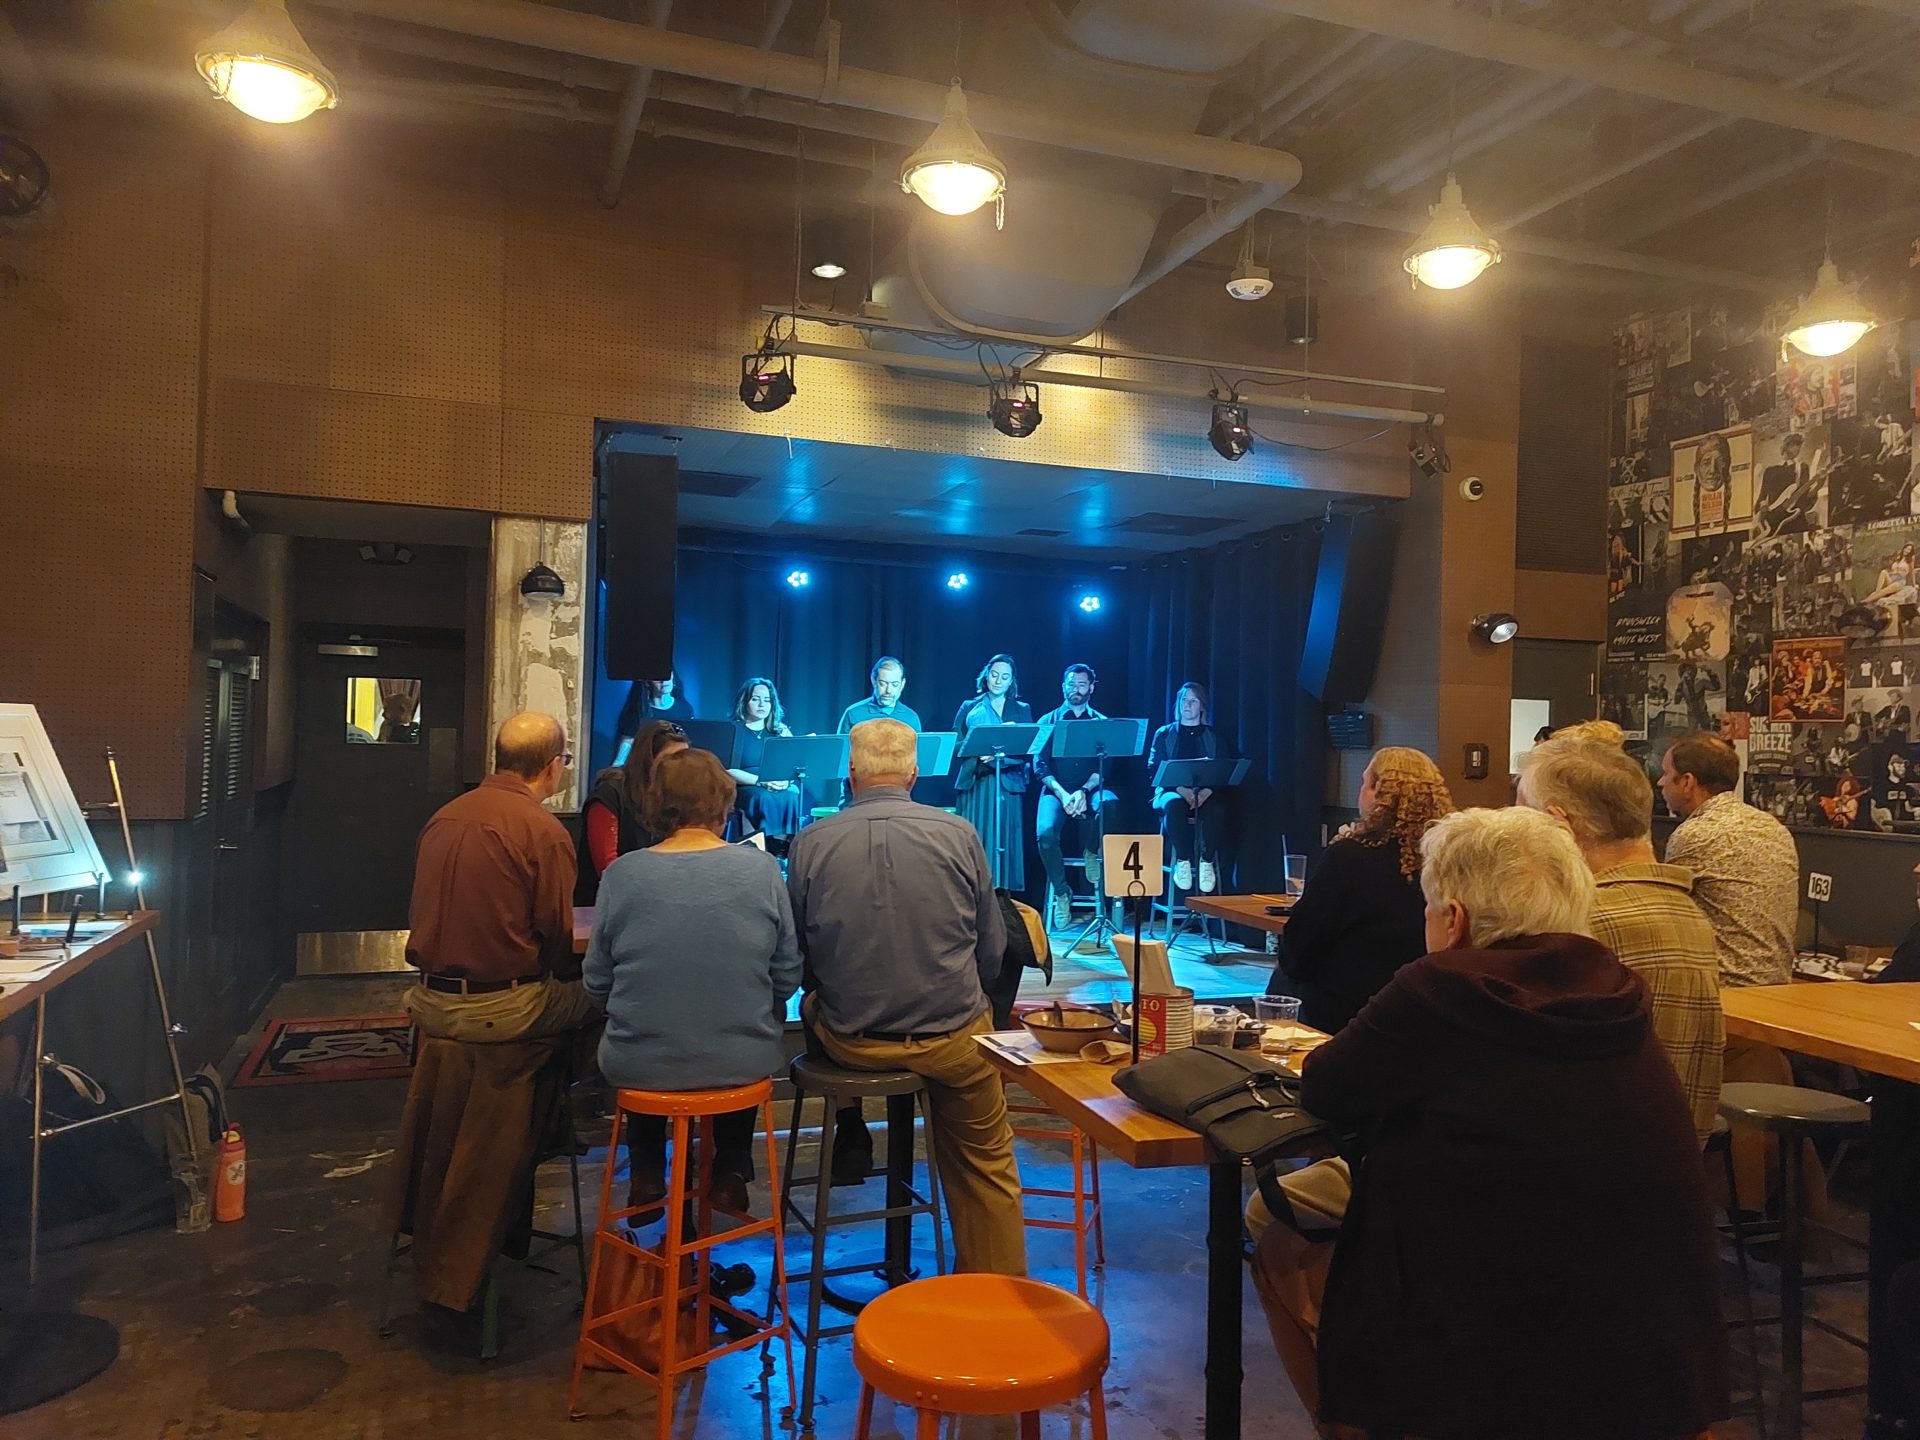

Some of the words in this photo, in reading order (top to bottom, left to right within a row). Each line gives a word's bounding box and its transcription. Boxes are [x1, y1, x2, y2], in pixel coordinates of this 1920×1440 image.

[1639, 633, 1661, 645] WEST
[1749, 733, 1792, 753] BREEZE
[1123, 841, 1143, 879] 4
[1811, 876, 1829, 896] 163
